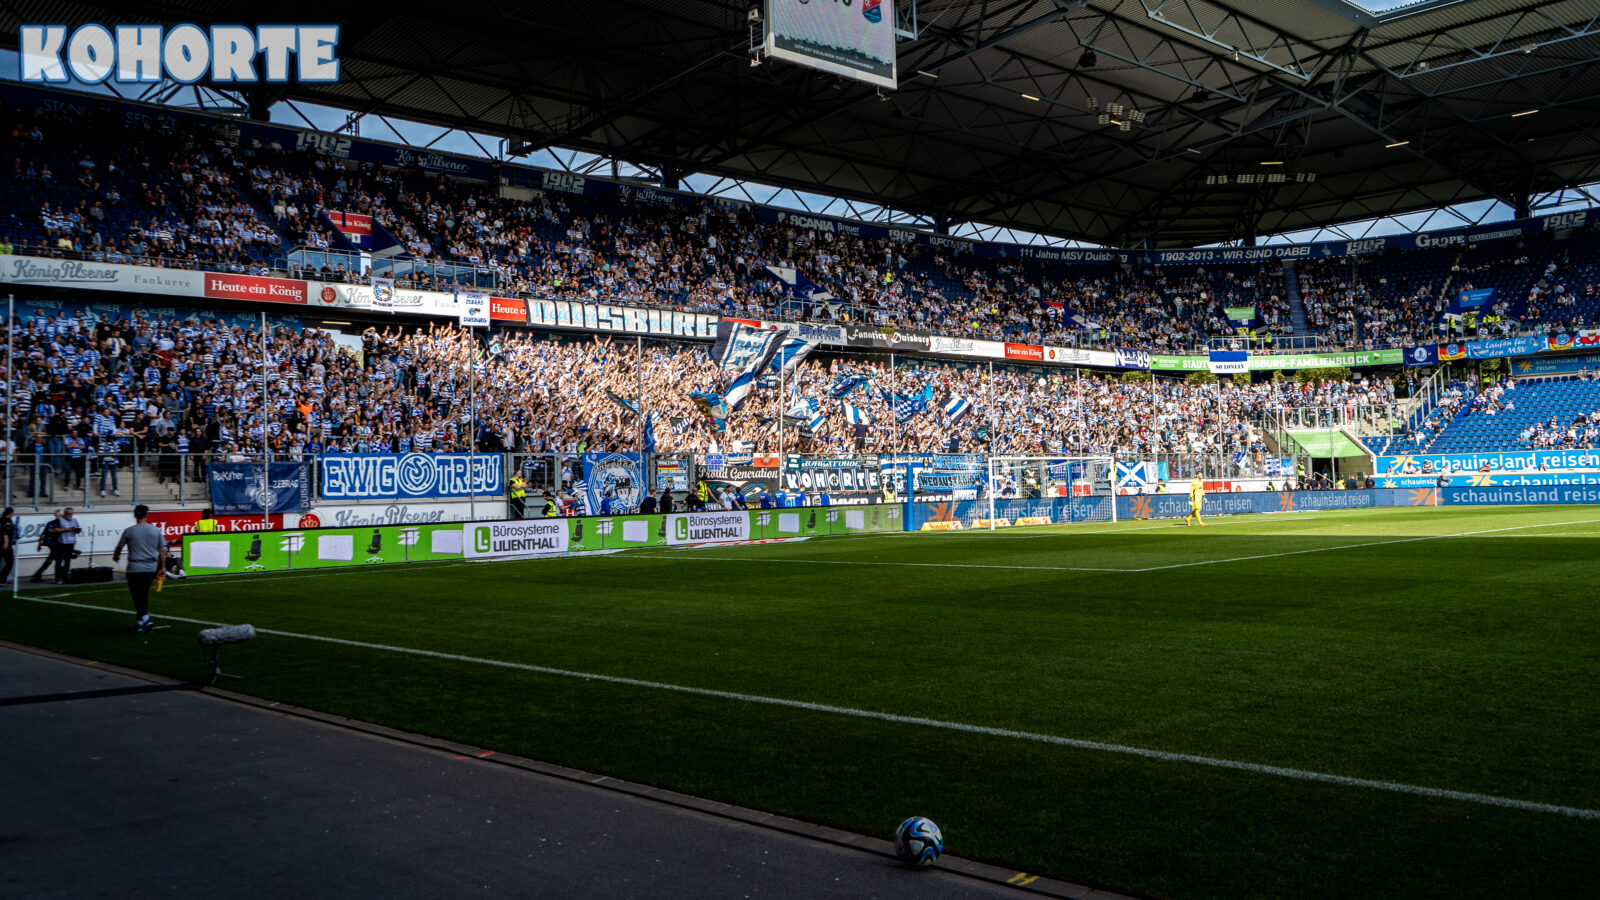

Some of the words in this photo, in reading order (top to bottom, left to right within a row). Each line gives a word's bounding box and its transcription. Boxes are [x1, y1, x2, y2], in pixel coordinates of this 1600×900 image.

[542, 172, 586, 190] 1902
[789, 214, 835, 233] SCANIA
[837, 223, 860, 235] Breuer
[1542, 212, 1588, 232] 1902
[1019, 248, 1034, 259] 111
[1035, 249, 1060, 261] Jahre
[1061, 250, 1084, 261] MSV
[1160, 251, 1214, 262] 1902-2013
[1223, 249, 1244, 260] WIR
[1245, 248, 1274, 260] SIND
[1275, 246, 1311, 258] DABEI
[1346, 239, 1386, 254] 1902
[11, 259, 62, 282] König
[61, 261, 119, 280] Pilsener
[134, 274, 191, 288] Fankurve
[211, 280, 247, 293] Heute
[249, 284, 267, 295] ein
[269, 284, 303, 302] König
[492, 303, 520, 315] Heute
[892, 331, 931, 350] Duisburg
[1506, 346, 1528, 355] MSV
[1137, 350, 1150, 369] 89
[1432, 452, 1537, 472] chauinsland
[1542, 452, 1600, 469] reisen
[323, 456, 398, 496] EWIG
[435, 454, 501, 495] TREU
[730, 467, 779, 481] Generation
[786, 471, 878, 490] KOHORTE
[272, 479, 299, 489] ZEBRAS
[298, 465, 310, 509] DUISBURG
[1225, 495, 1252, 511] reisen
[1300, 491, 1347, 507] schauinsland
[1348, 490, 1370, 505] reisen
[1453, 486, 1561, 504] schauinsland
[385, 504, 445, 525] Pilsener
[689, 514, 743, 528] Bürosysteme
[152, 523, 196, 536] Heute
[492, 524, 559, 539] Bürosysteme
[690, 527, 740, 541] LILIENTHAL
[493, 537, 555, 553] LILIENTHAL
